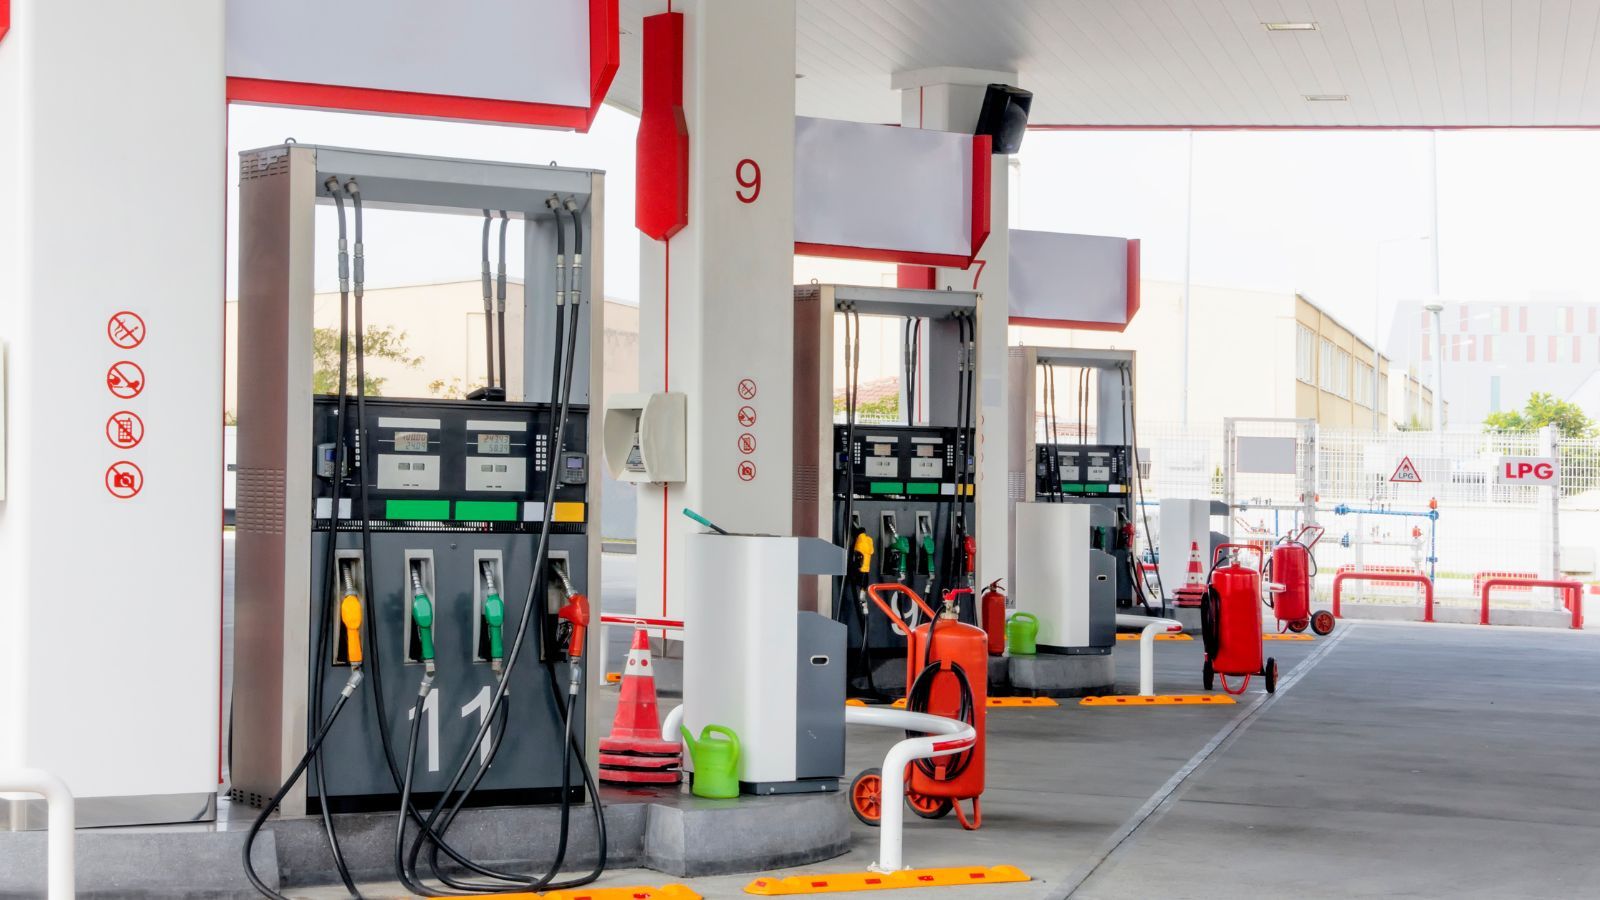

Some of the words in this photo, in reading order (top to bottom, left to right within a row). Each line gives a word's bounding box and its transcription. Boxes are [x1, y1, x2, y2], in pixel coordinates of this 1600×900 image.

[735, 158, 762, 204] 9
[972, 259, 987, 290] 7
[1398, 472, 1414, 480] LPG
[1505, 462, 1554, 480] LPG
[891, 590, 919, 636] 9
[408, 685, 492, 772] 11
